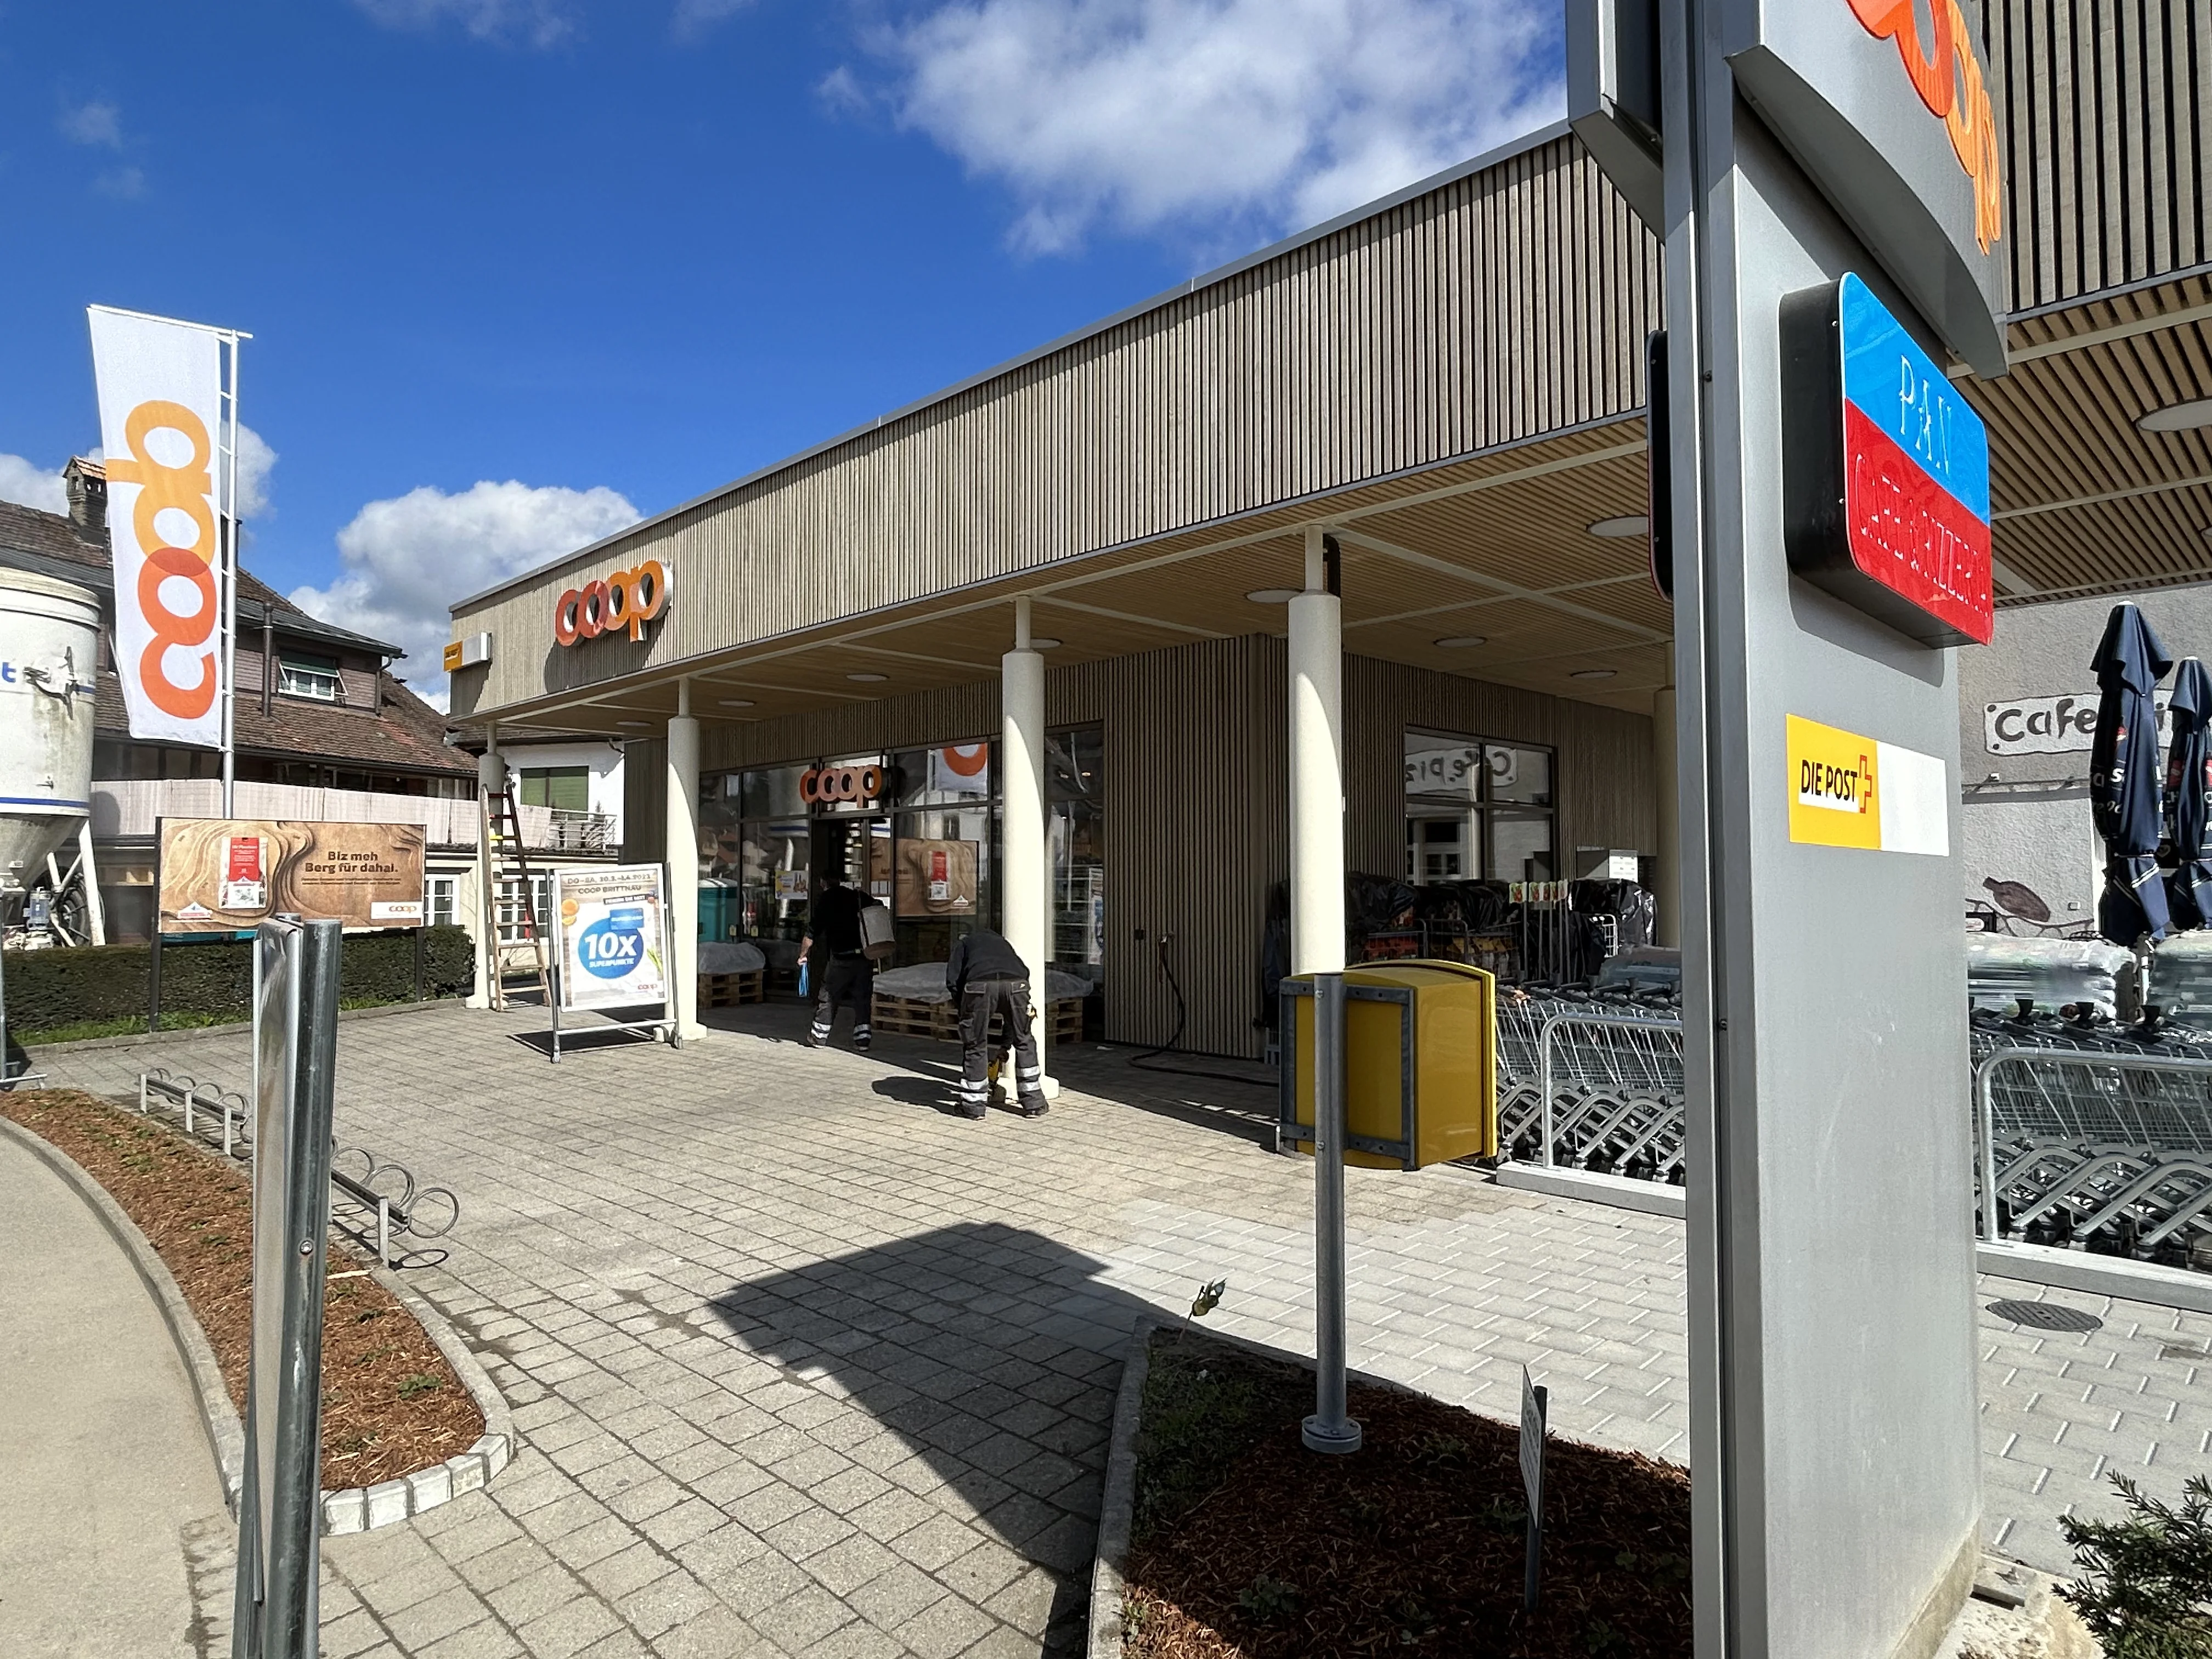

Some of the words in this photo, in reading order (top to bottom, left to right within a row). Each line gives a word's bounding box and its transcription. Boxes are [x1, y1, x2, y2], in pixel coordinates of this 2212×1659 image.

[1846, 0, 2001, 256] oop
[1899, 355, 1953, 478] PAN
[106, 400, 217, 719] coop
[555, 560, 668, 647] coop
[800, 765, 882, 808] coop
[1801, 759, 1822, 796] DIE
[1826, 765, 1858, 802] POST
[305, 863, 336, 874] Berg
[338, 863, 358, 872] für
[388, 905, 417, 913] coop
